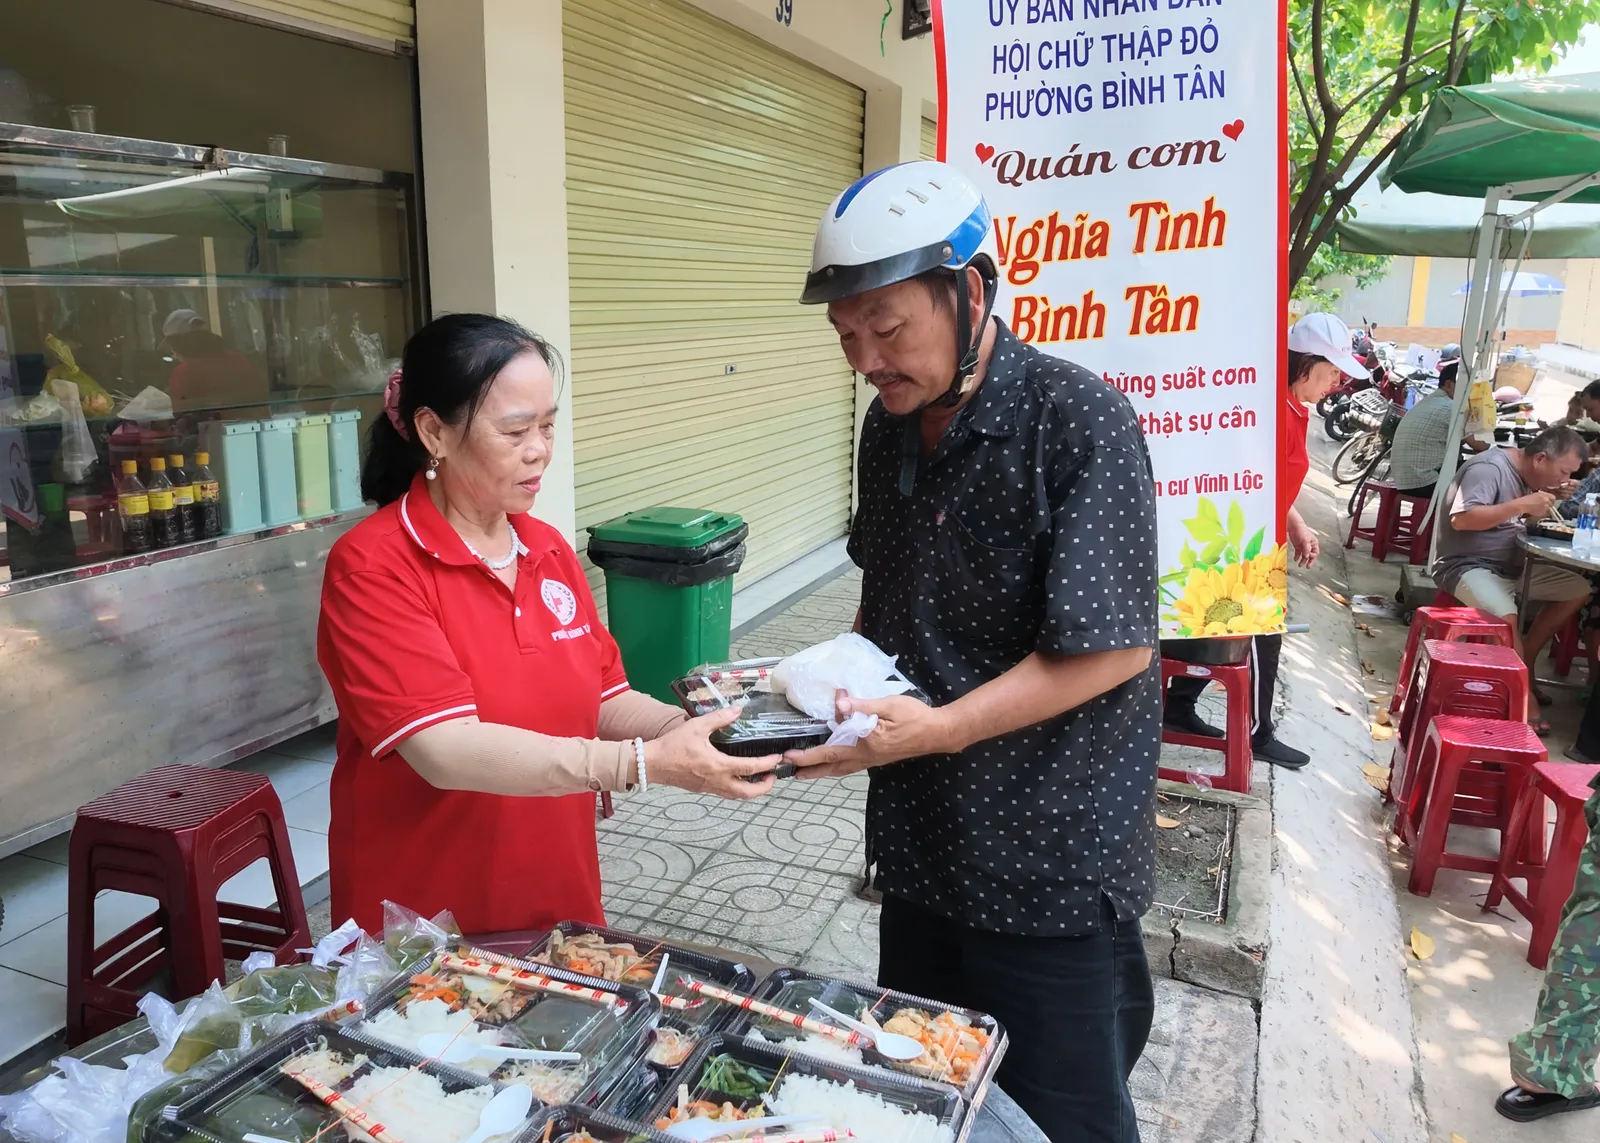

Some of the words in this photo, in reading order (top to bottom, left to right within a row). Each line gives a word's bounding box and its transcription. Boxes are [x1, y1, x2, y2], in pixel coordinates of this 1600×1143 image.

[993, 38, 1030, 80] HỘI
[1038, 30, 1094, 71] CHỮ
[1101, 25, 1173, 66] THẬP
[1180, 17, 1219, 55] ĐỎ
[985, 81, 1093, 121] PHƯỜNG
[1102, 71, 1165, 109] BÌNH
[1174, 64, 1225, 101] TÂN
[991, 143, 1117, 187] Quán
[1127, 138, 1227, 169] cơm
[1129, 195, 1227, 255] Tình
[1010, 289, 1106, 344] Bình
[1124, 284, 1200, 336] Tân
[1103, 371, 1156, 399] hững
[1162, 366, 1206, 391] suất
[1212, 366, 1257, 387] cơm
[1138, 411, 1183, 439] thật
[1189, 412, 1213, 435] sự
[1219, 405, 1257, 430] cần
[1168, 478, 1190, 496] cư
[1194, 473, 1229, 494] Vĩnh
[1234, 469, 1263, 495] Lộc
